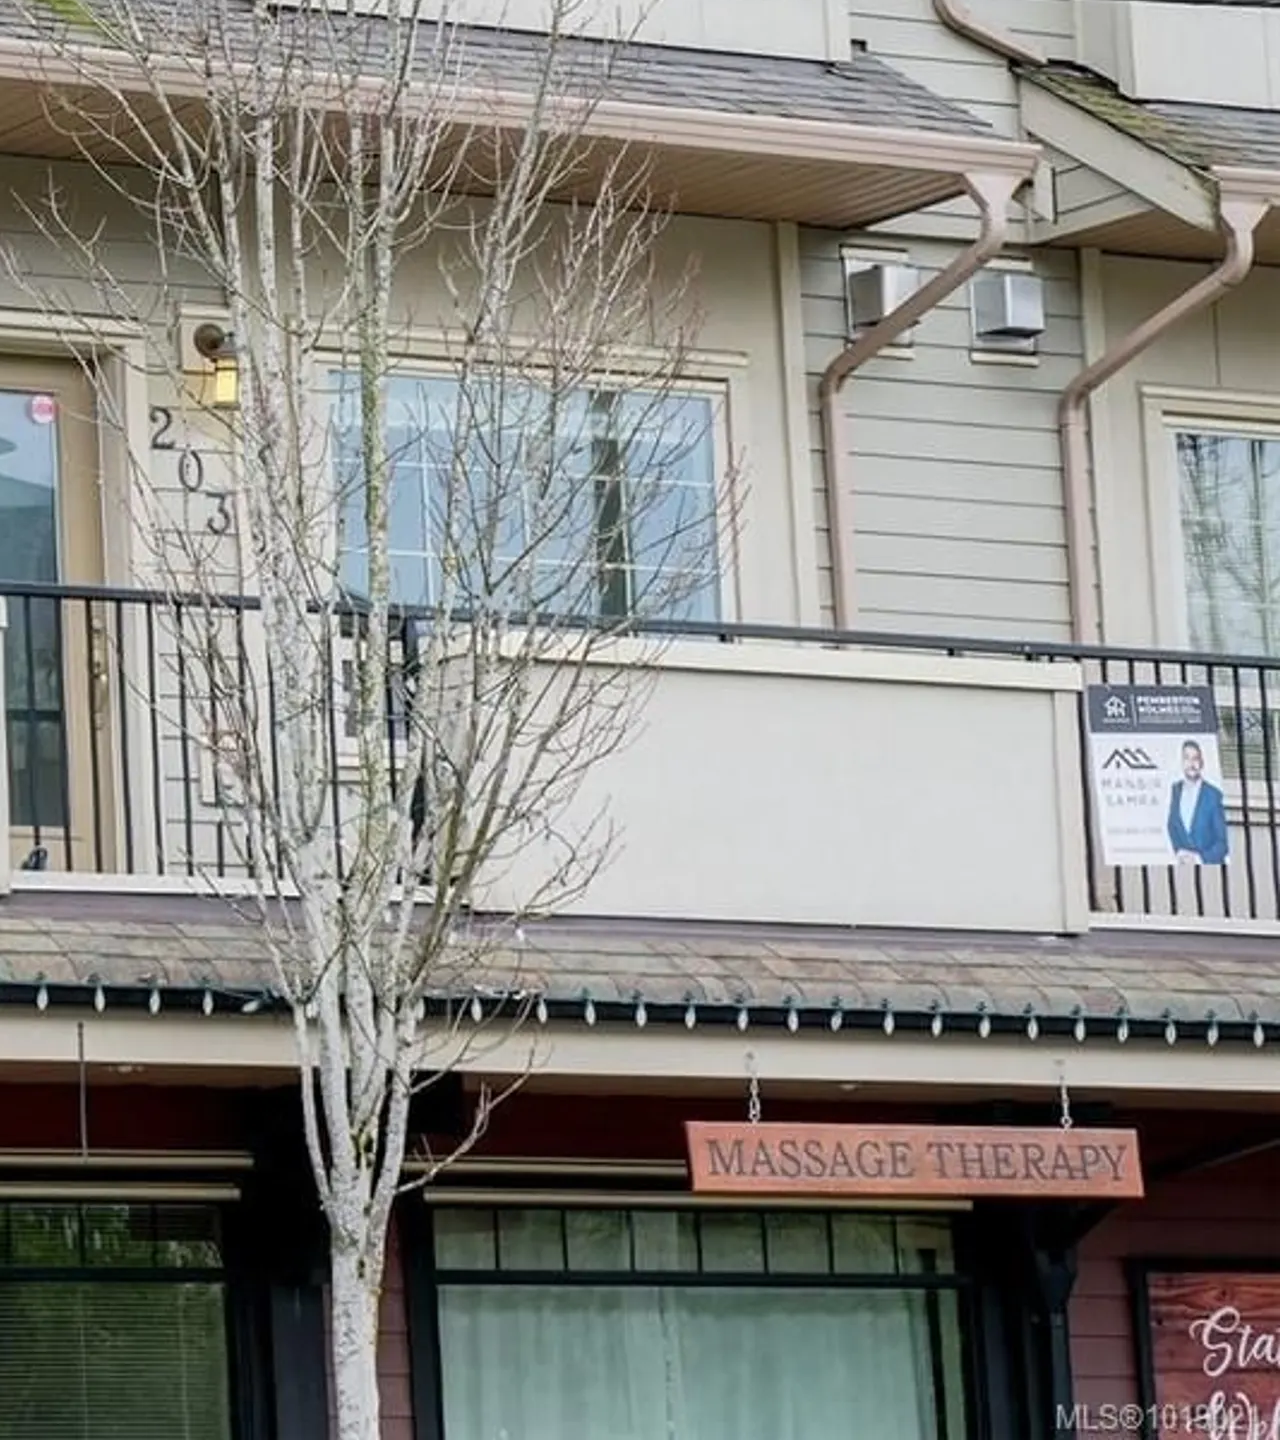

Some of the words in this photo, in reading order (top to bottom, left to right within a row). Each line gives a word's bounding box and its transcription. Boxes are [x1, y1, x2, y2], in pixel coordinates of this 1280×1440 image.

[705, 1139, 916, 1180] MASSAGE
[926, 1141, 1128, 1183] THERAPY
[1189, 1306, 1280, 1377] Sta
